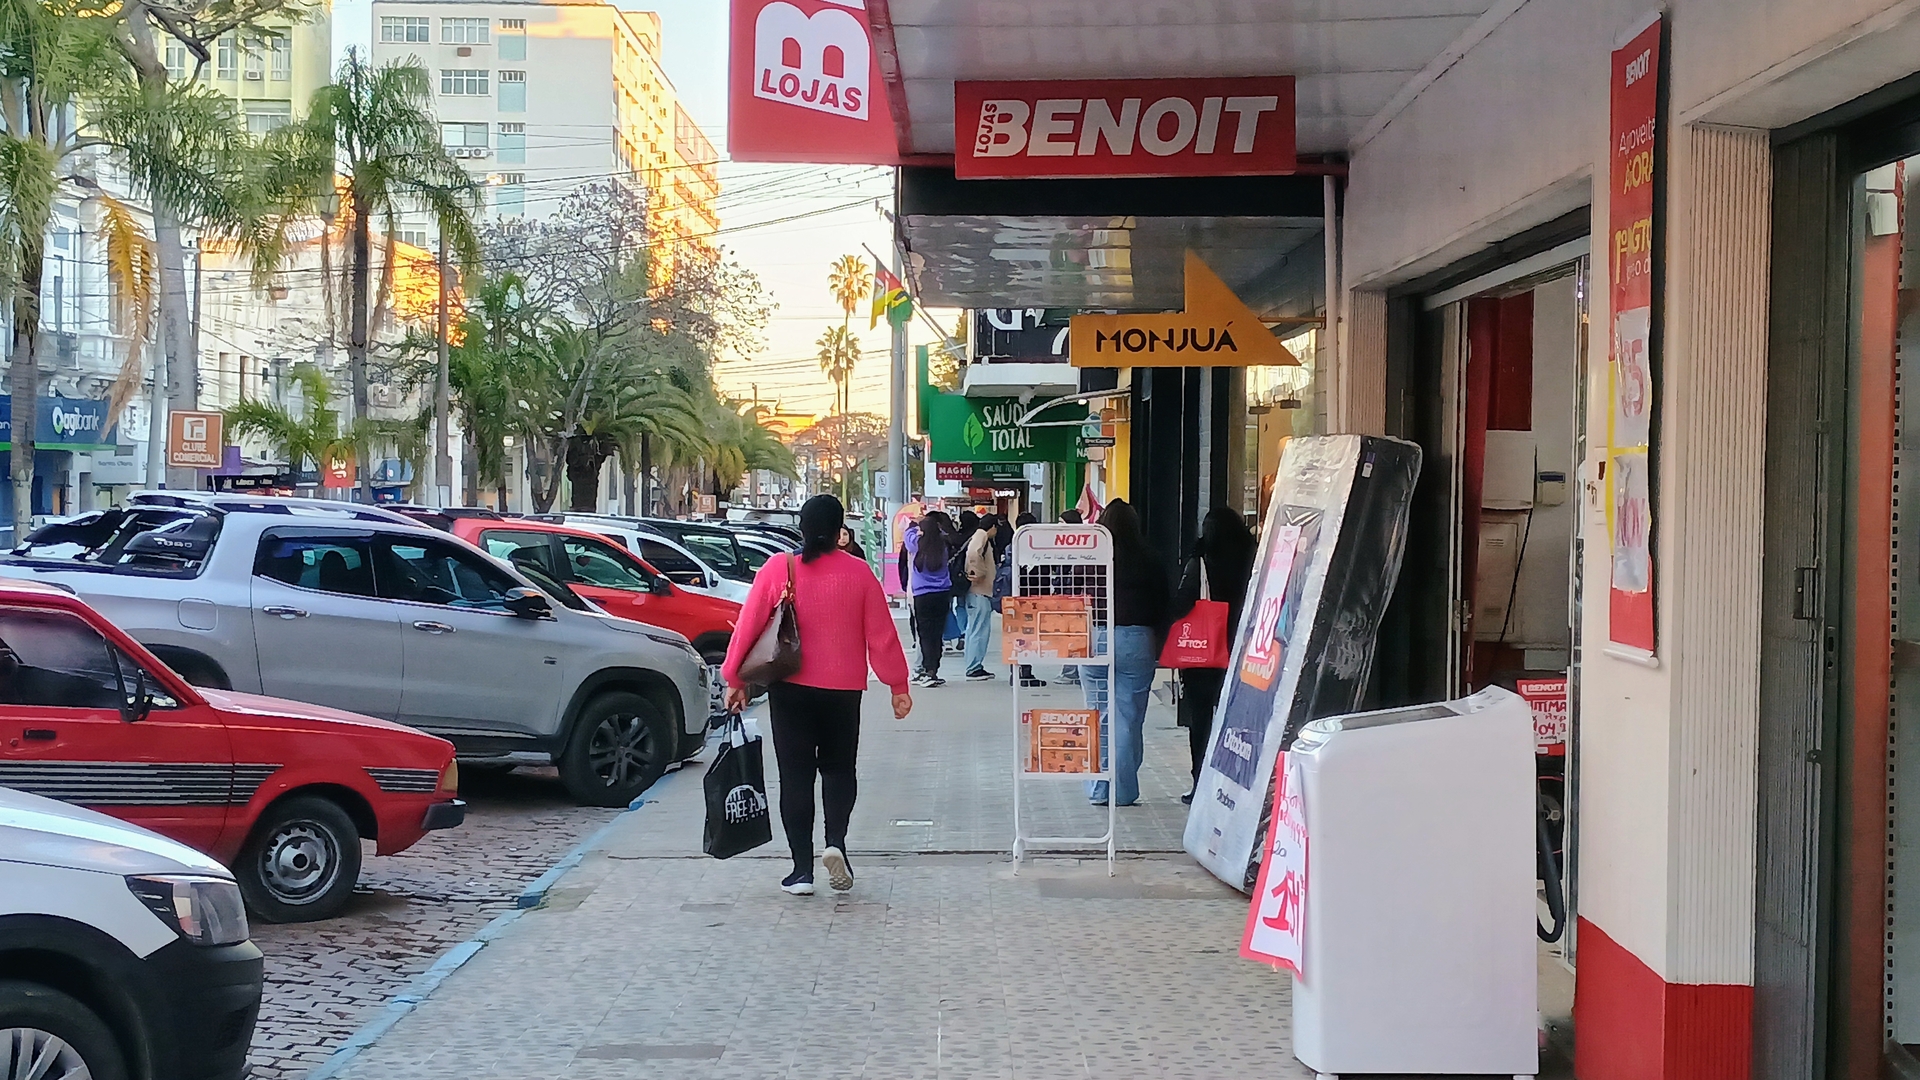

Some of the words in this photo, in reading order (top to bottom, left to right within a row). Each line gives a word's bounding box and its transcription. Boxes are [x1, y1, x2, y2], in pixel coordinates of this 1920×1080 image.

[1625, 47, 1651, 88] BENOIT
[760, 67, 863, 112] LOJAS
[972, 95, 1279, 158] BENOIT
[975, 102, 998, 154] LOJAS
[1096, 320, 1238, 353] MONJUÁ
[62, 407, 99, 436] agibank
[182, 441, 207, 452] CLUBE
[988, 428, 1035, 452] TOTAL
[173, 452, 216, 463] COMERCIAL
[1528, 683, 1563, 692] BENOIT
[1040, 712, 1091, 725] BENOIT
